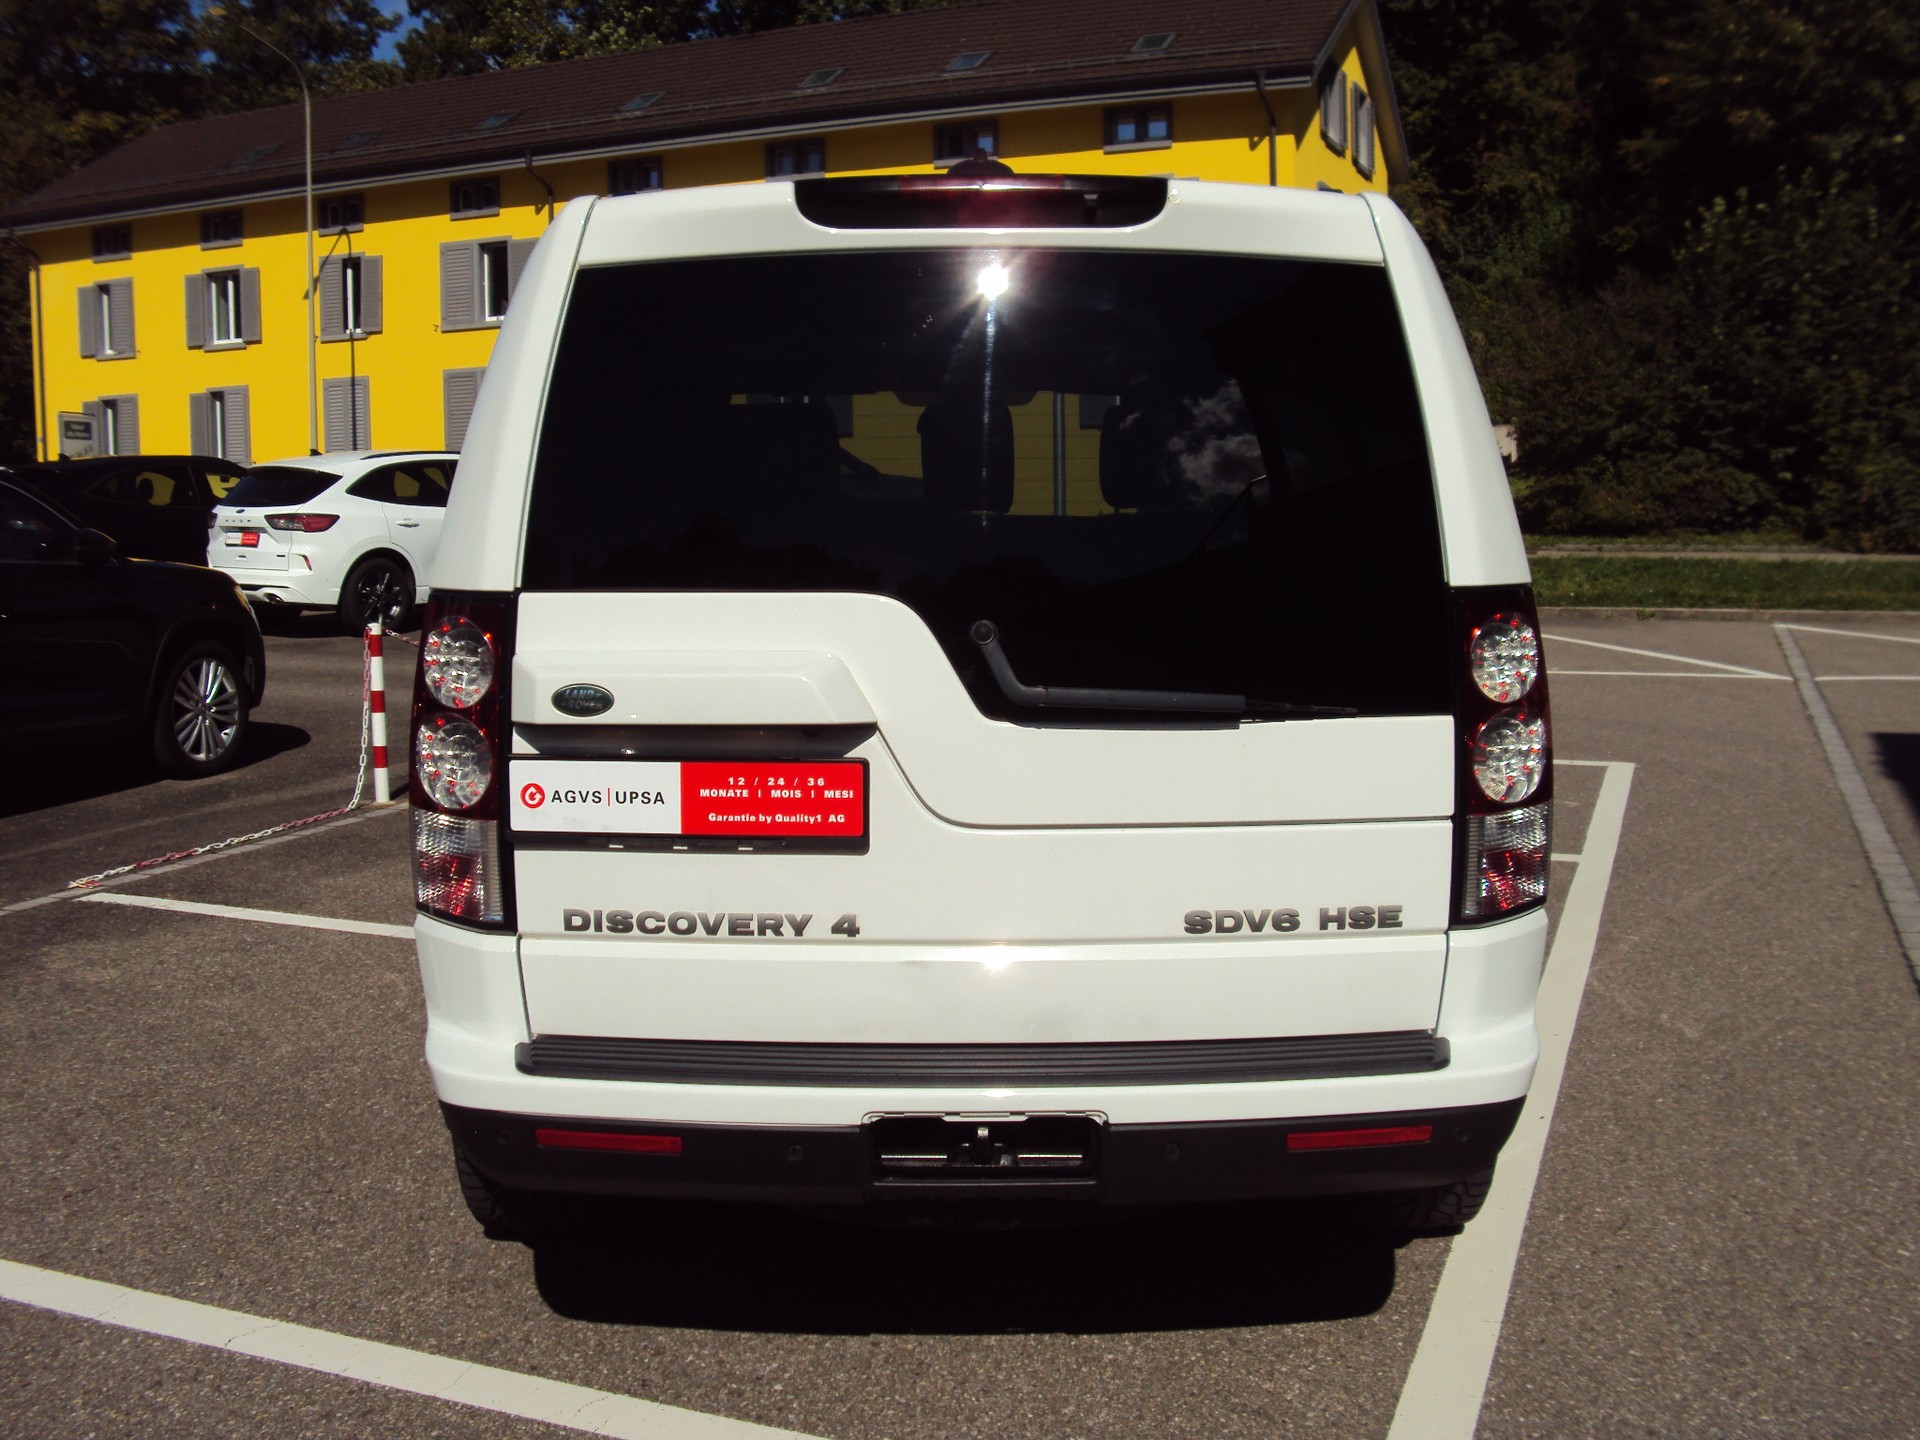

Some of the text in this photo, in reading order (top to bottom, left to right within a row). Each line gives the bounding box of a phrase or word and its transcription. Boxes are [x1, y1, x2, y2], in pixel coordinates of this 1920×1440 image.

[564, 689, 595, 699] LAND
[728, 777, 746, 785] 12
[767, 777, 785, 786] 24
[807, 777, 825, 786] 36
[550, 789, 665, 805] AGVS UPSA
[700, 789, 749, 798] MONATE
[770, 789, 802, 799] MOIS
[824, 790, 854, 799] MESI
[708, 813, 846, 825] Garantie by Quality1 AG
[562, 908, 861, 938] DISCOVERY 4
[1183, 905, 1403, 935] SDV6 HSE
